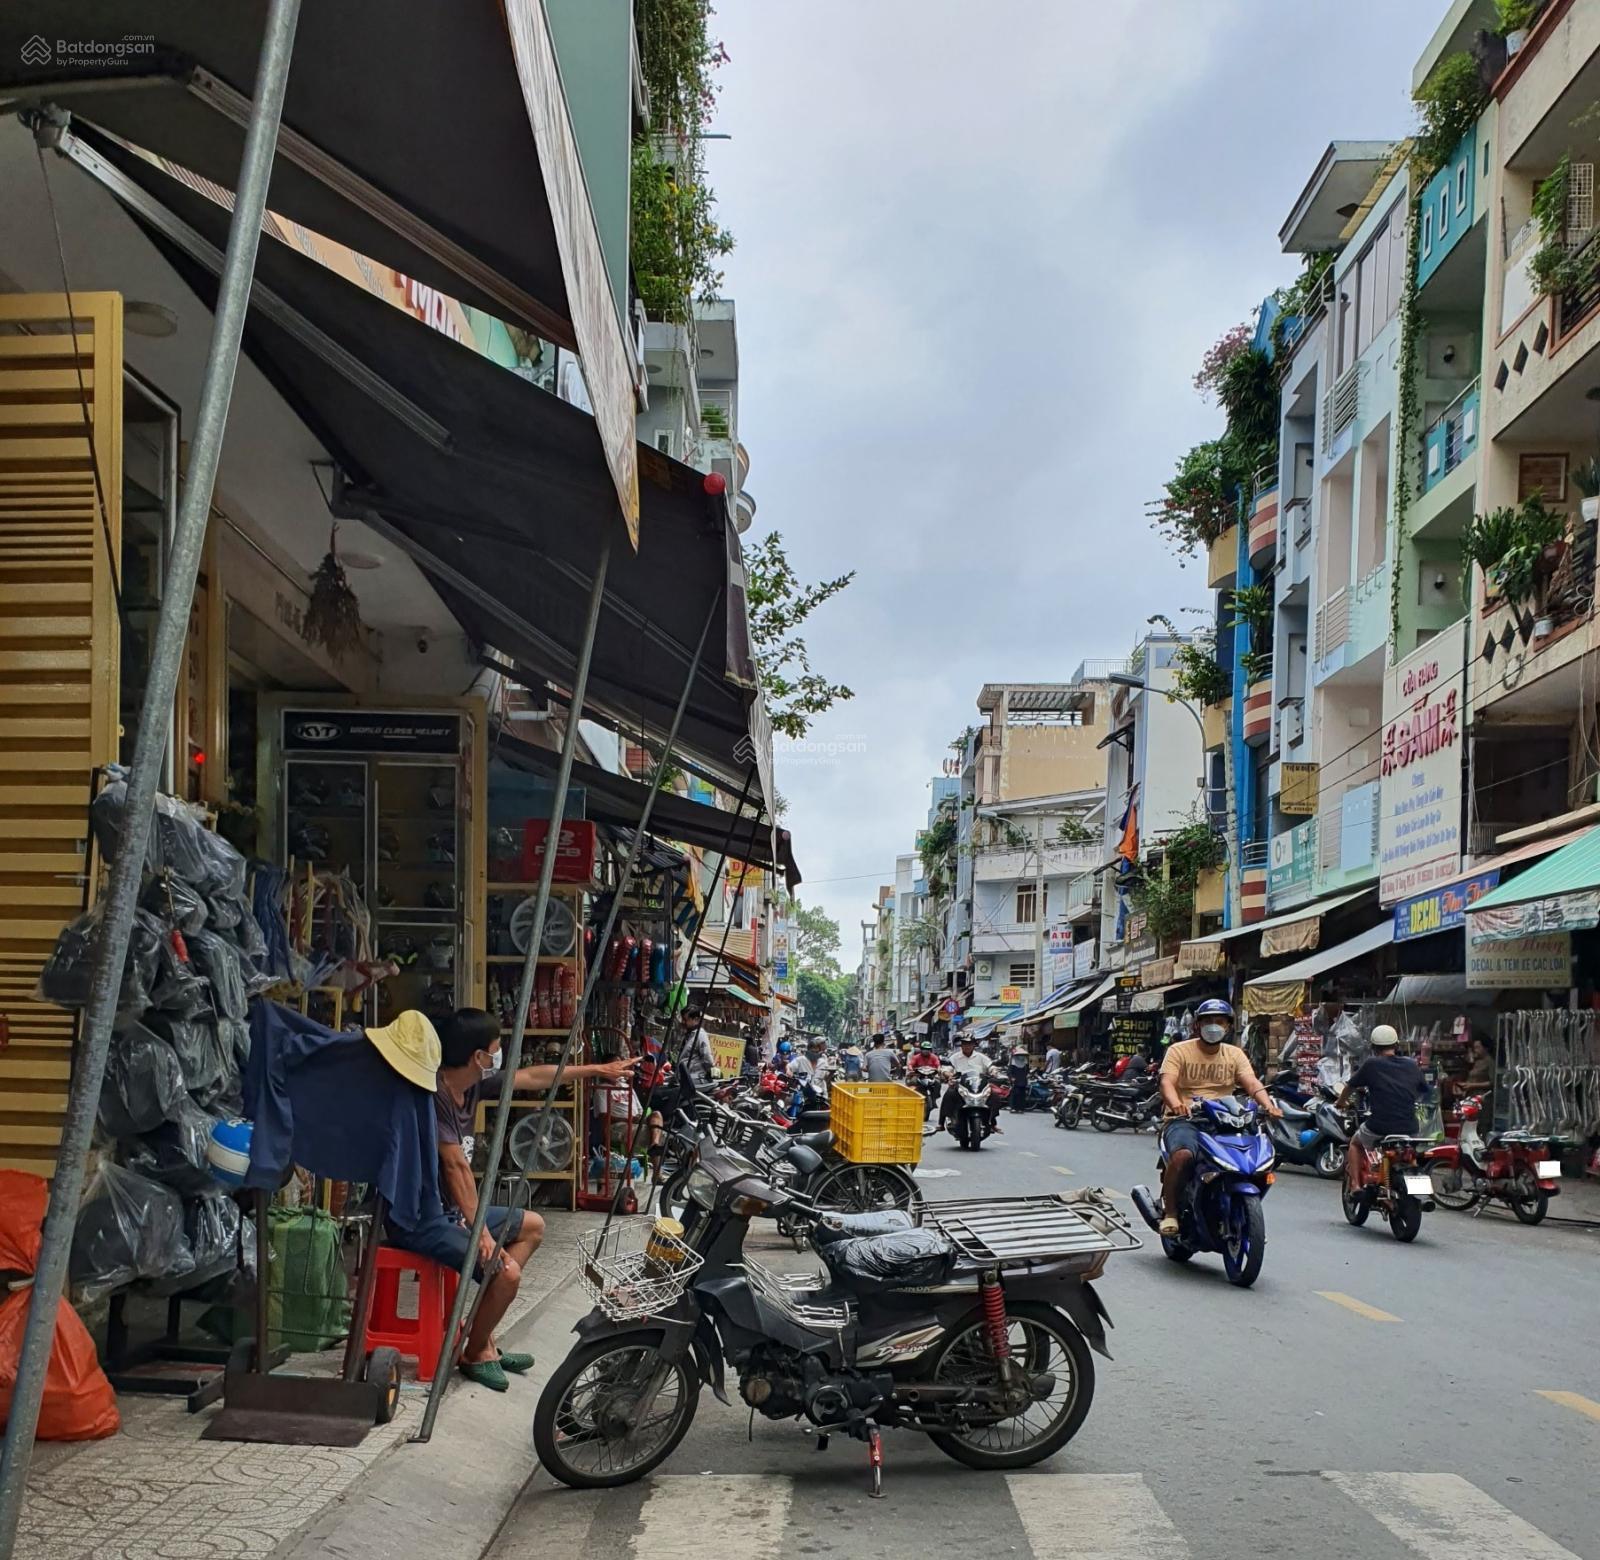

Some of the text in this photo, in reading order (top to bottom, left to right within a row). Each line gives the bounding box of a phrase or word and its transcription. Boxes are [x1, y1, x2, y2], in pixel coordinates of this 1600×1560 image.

[296, 723, 339, 740] KYT
[1409, 896, 1440, 935] DECAL
[1471, 959, 1494, 971] DECAL
[1504, 959, 1520, 971] TEM
[1522, 959, 1531, 971] XE
[1123, 1019, 1153, 1030] SHOP
[724, 1055, 738, 1069] XE
